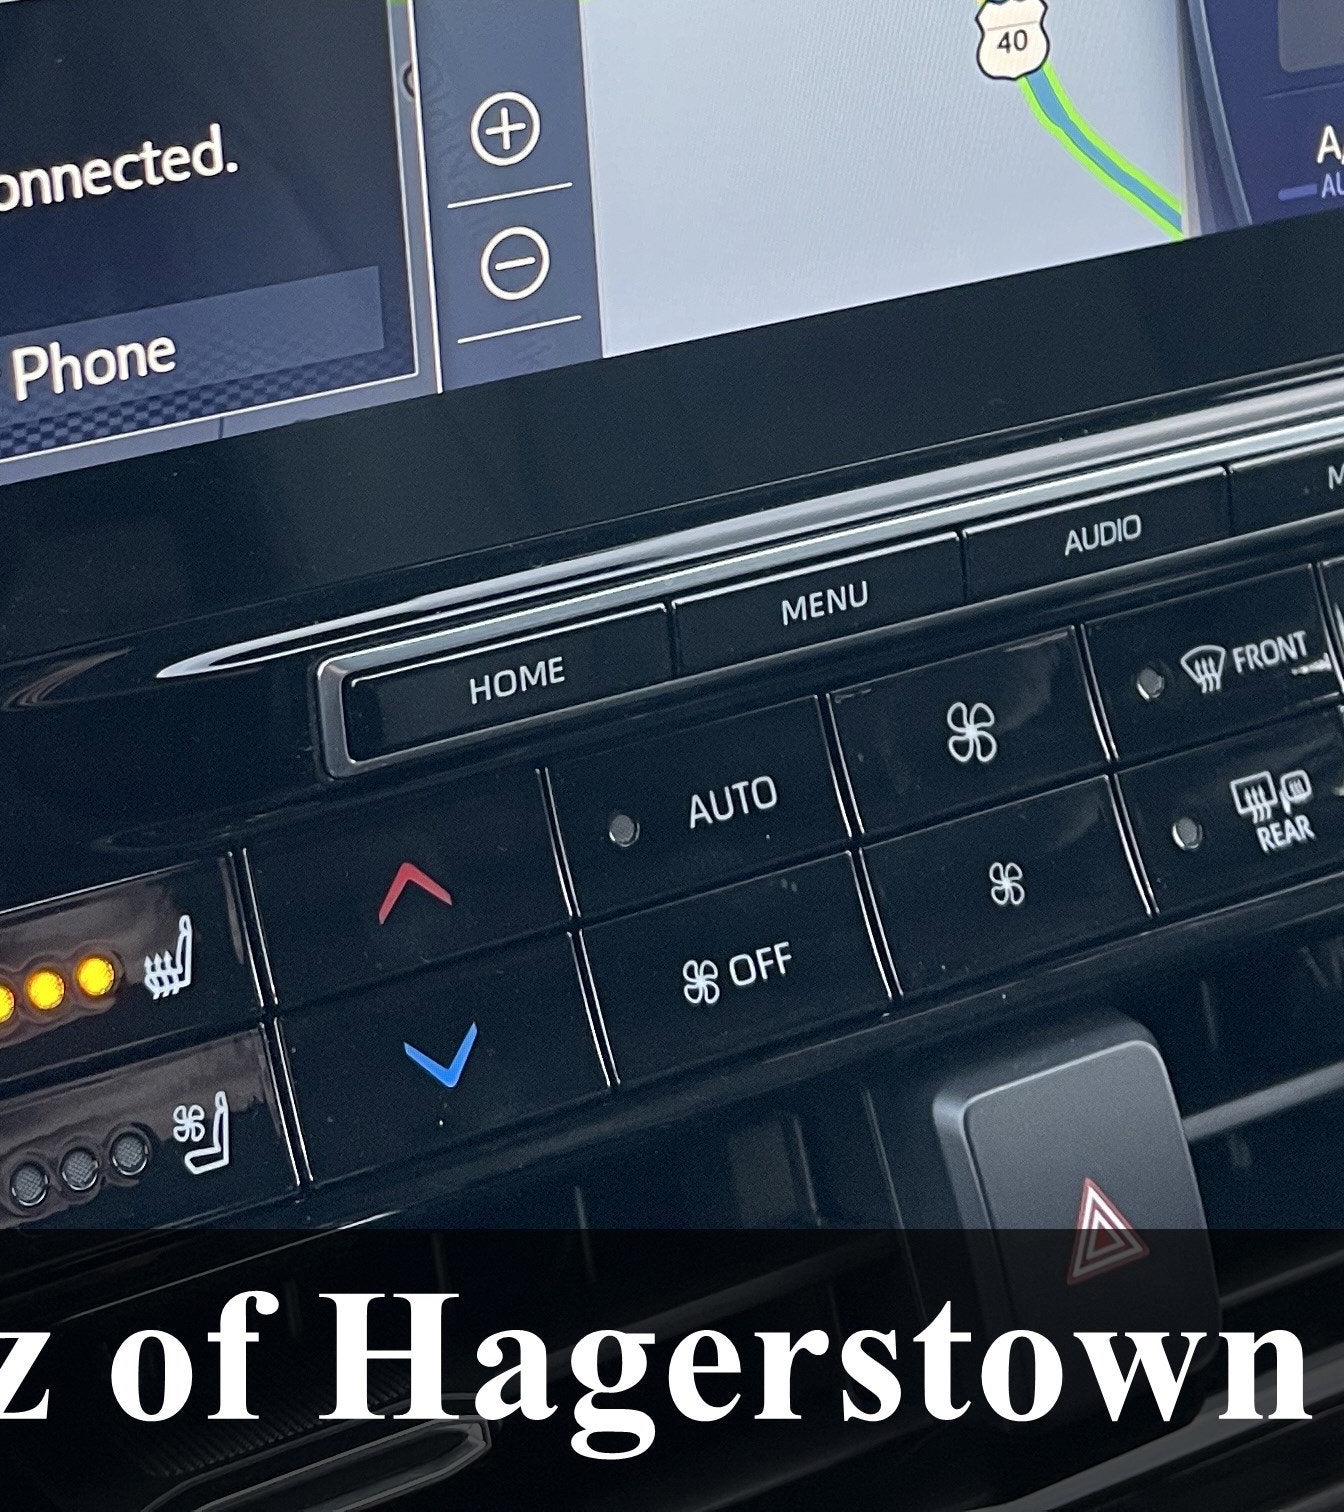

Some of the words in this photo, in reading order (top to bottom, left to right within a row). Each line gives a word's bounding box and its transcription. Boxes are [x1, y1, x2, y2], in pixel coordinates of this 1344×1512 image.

[997, 28, 1028, 54] 40
[11, 334, 177, 401] Phone
[1063, 514, 1143, 556] AUDIO
[780, 580, 870, 626] MENU
[1231, 630, 1308, 675] FRONT
[467, 656, 567, 705] HOME
[687, 774, 779, 830] AUTO
[1256, 816, 1316, 853] REAR
[728, 941, 794, 988] OFF
